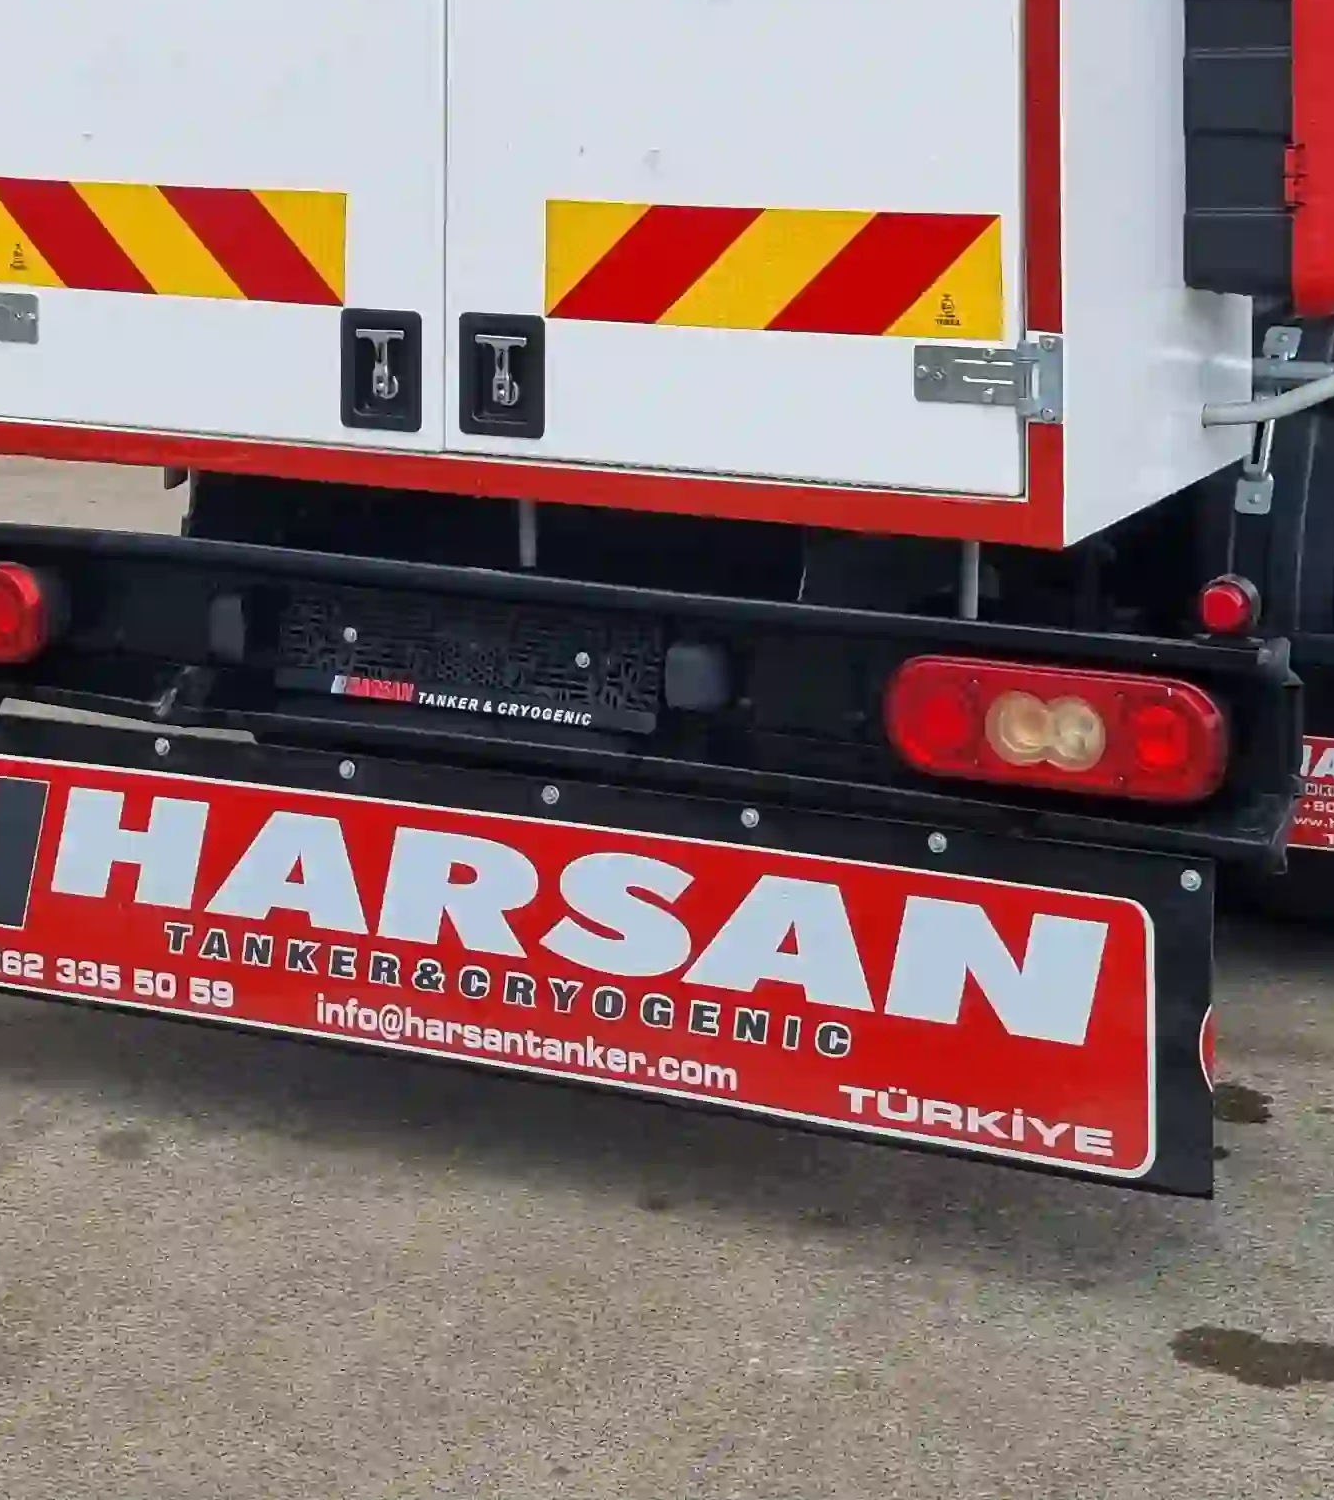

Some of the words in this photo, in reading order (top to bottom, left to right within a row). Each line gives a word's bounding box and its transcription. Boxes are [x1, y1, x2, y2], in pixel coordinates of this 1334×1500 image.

[418, 692, 478, 712] TANKER
[483, 699, 493, 713] &
[498, 703, 592, 726] CRYOGENIC
[51, 786, 1110, 1046] HARSAN
[56, 957, 121, 991] 335
[133, 968, 177, 1001] 50
[189, 976, 234, 1008] 59
[316, 992, 738, 1092] info@harsantanker.com
[838, 1084, 1114, 1157] TÜRKİYE
